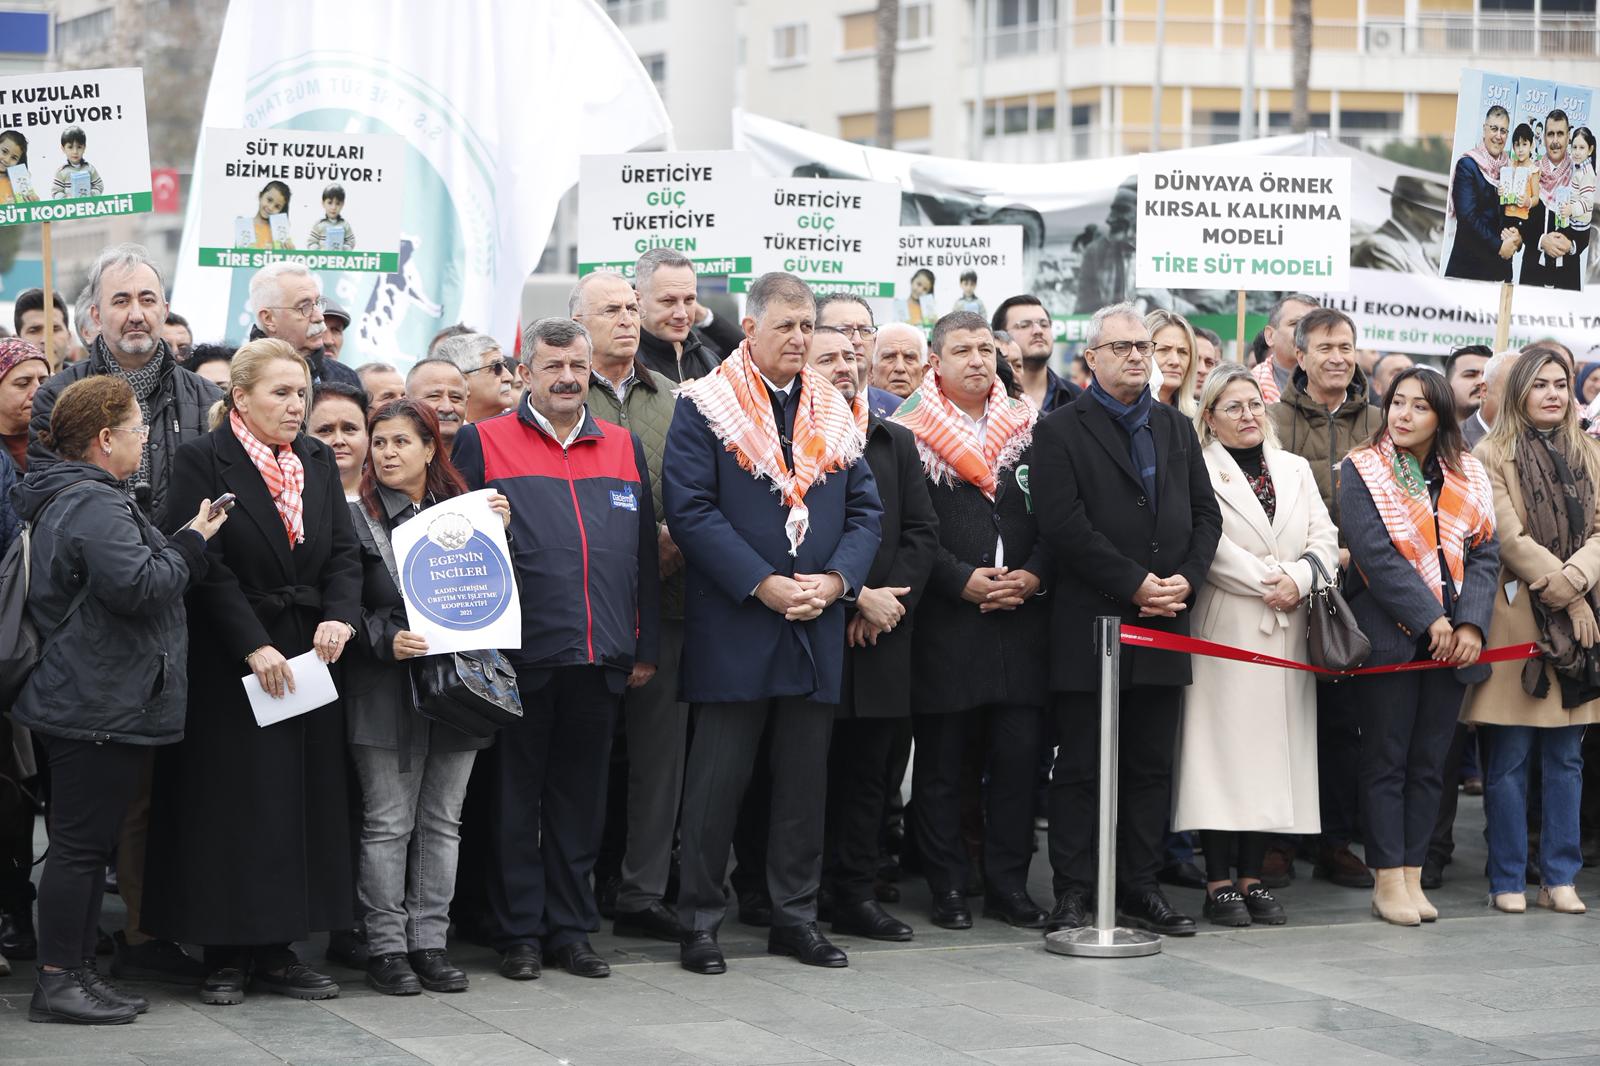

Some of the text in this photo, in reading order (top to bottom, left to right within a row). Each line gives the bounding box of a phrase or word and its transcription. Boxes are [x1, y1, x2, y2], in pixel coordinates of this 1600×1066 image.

[12, 83, 100, 104] KUZULARI
[1487, 83, 1510, 100] SÜT
[1526, 88, 1549, 104] SÜT
[1562, 96, 1585, 111] SÜT
[0, 112, 22, 129] LE
[27, 105, 112, 126] BÜYÜYOR
[246, 138, 364, 160] SÜT KUZULARI
[226, 159, 290, 179] BİZİMLE
[294, 162, 373, 182] BÜYÜYOR
[621, 163, 713, 183] ÜRETİCİYE
[1154, 169, 1333, 194] DÜNYAYA ÖRNEK
[646, 187, 686, 208] GÜÇ
[774, 189, 862, 209] ÜRETİCİYE
[31, 195, 133, 221] KOOPERATİFİ
[1145, 200, 1342, 220] KIRSAL KALKINMA
[612, 210, 715, 231] TÜKETİCİYE
[797, 212, 835, 232] GÜÇ
[634, 235, 697, 253] GÜVEN
[763, 232, 862, 252] TÜKETİCİYE
[899, 234, 991, 249] SÜT KUZULARI
[1202, 224, 1283, 245] MODELİ
[217, 249, 250, 267] TİRE
[783, 255, 843, 273] GÜVEN
[896, 253, 933, 266] ZİMLE
[937, 252, 998, 266] BÜYÜYOR
[1152, 251, 1333, 276] TİRE SÜT MODELİ
[1316, 292, 1357, 313] İLLİ
[1364, 301, 1498, 325] EKONOMİNİN
[1362, 324, 1395, 341] TİRE
[1399, 327, 1430, 344] SÜT
[429, 551, 483, 567] EGE'NİN
[430, 565, 488, 580] İNCİLERİ
